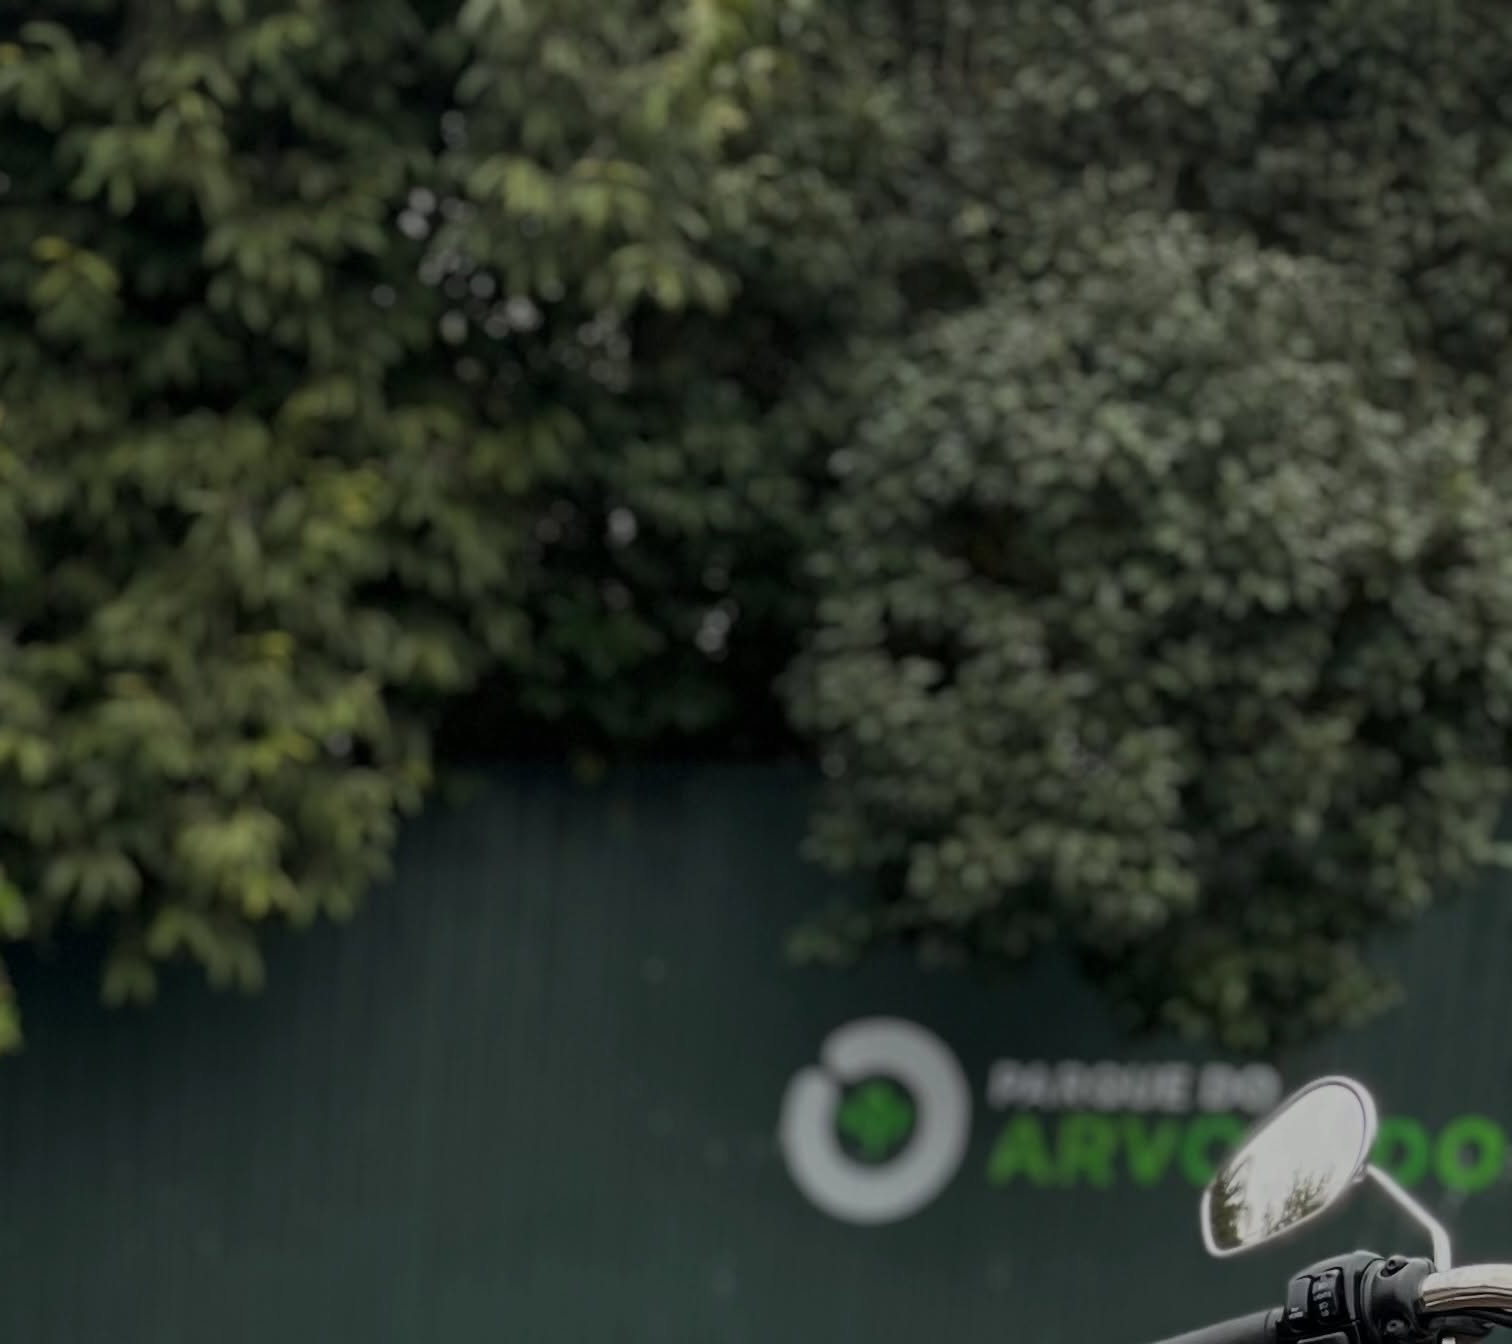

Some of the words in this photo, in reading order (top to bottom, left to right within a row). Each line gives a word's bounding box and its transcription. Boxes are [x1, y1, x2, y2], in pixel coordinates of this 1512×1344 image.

[989, 1061, 1190, 1110] PARQUE
[1198, 1061, 1282, 1112] DO
[991, 1114, 1504, 1191] ARVODO
